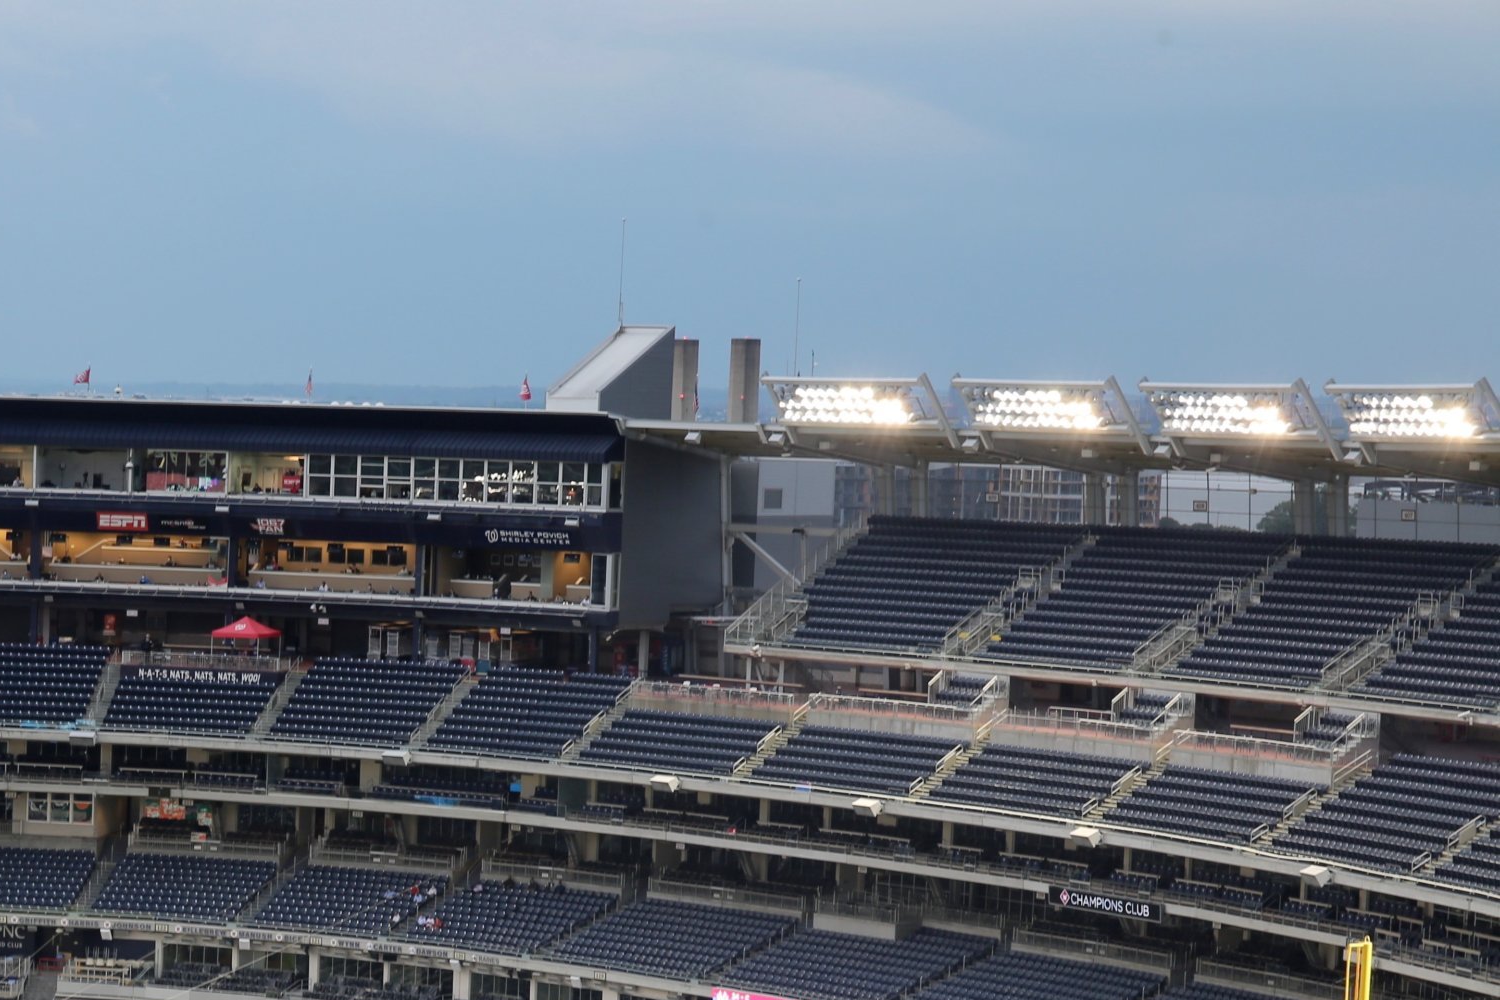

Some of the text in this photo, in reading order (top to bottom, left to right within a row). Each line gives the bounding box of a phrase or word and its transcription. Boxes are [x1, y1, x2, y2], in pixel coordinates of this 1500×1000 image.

[99, 514, 146, 528] ESPN
[500, 530, 534, 539] SHIRLEY
[169, 670, 192, 680] NATS,
[194, 671, 216, 681] NATS,
[217, 672, 239, 682] NATS,
[1070, 892, 1150, 917] CHAMPIONS CLUB
[68, 919, 99, 928] HARRIS
[111, 921, 150, 930] JOHNSON
[238, 931, 273, 940] MANUSH
[338, 940, 360, 949] WYNN
[416, 947, 448, 958] DAWSON
